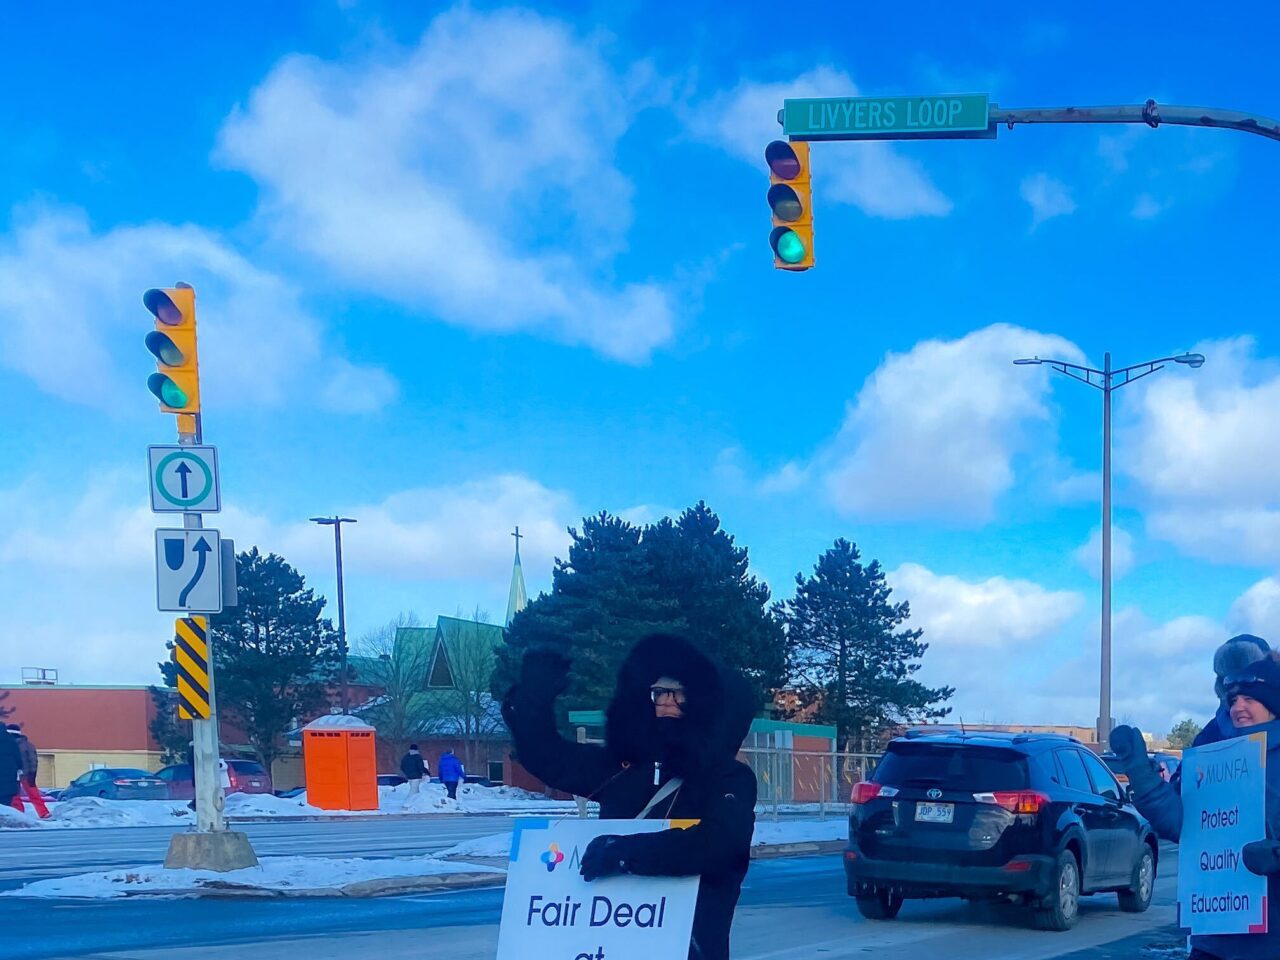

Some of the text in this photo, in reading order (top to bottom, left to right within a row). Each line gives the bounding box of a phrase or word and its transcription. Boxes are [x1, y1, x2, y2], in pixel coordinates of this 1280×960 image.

[808, 100, 963, 129] LIVYERS LOOP
[1205, 757, 1249, 785] MUNFA
[1201, 805, 1239, 829] Protect
[1200, 847, 1240, 873] Quality
[527, 895, 667, 928] Fair Deal
[1191, 893, 1249, 914] Education
